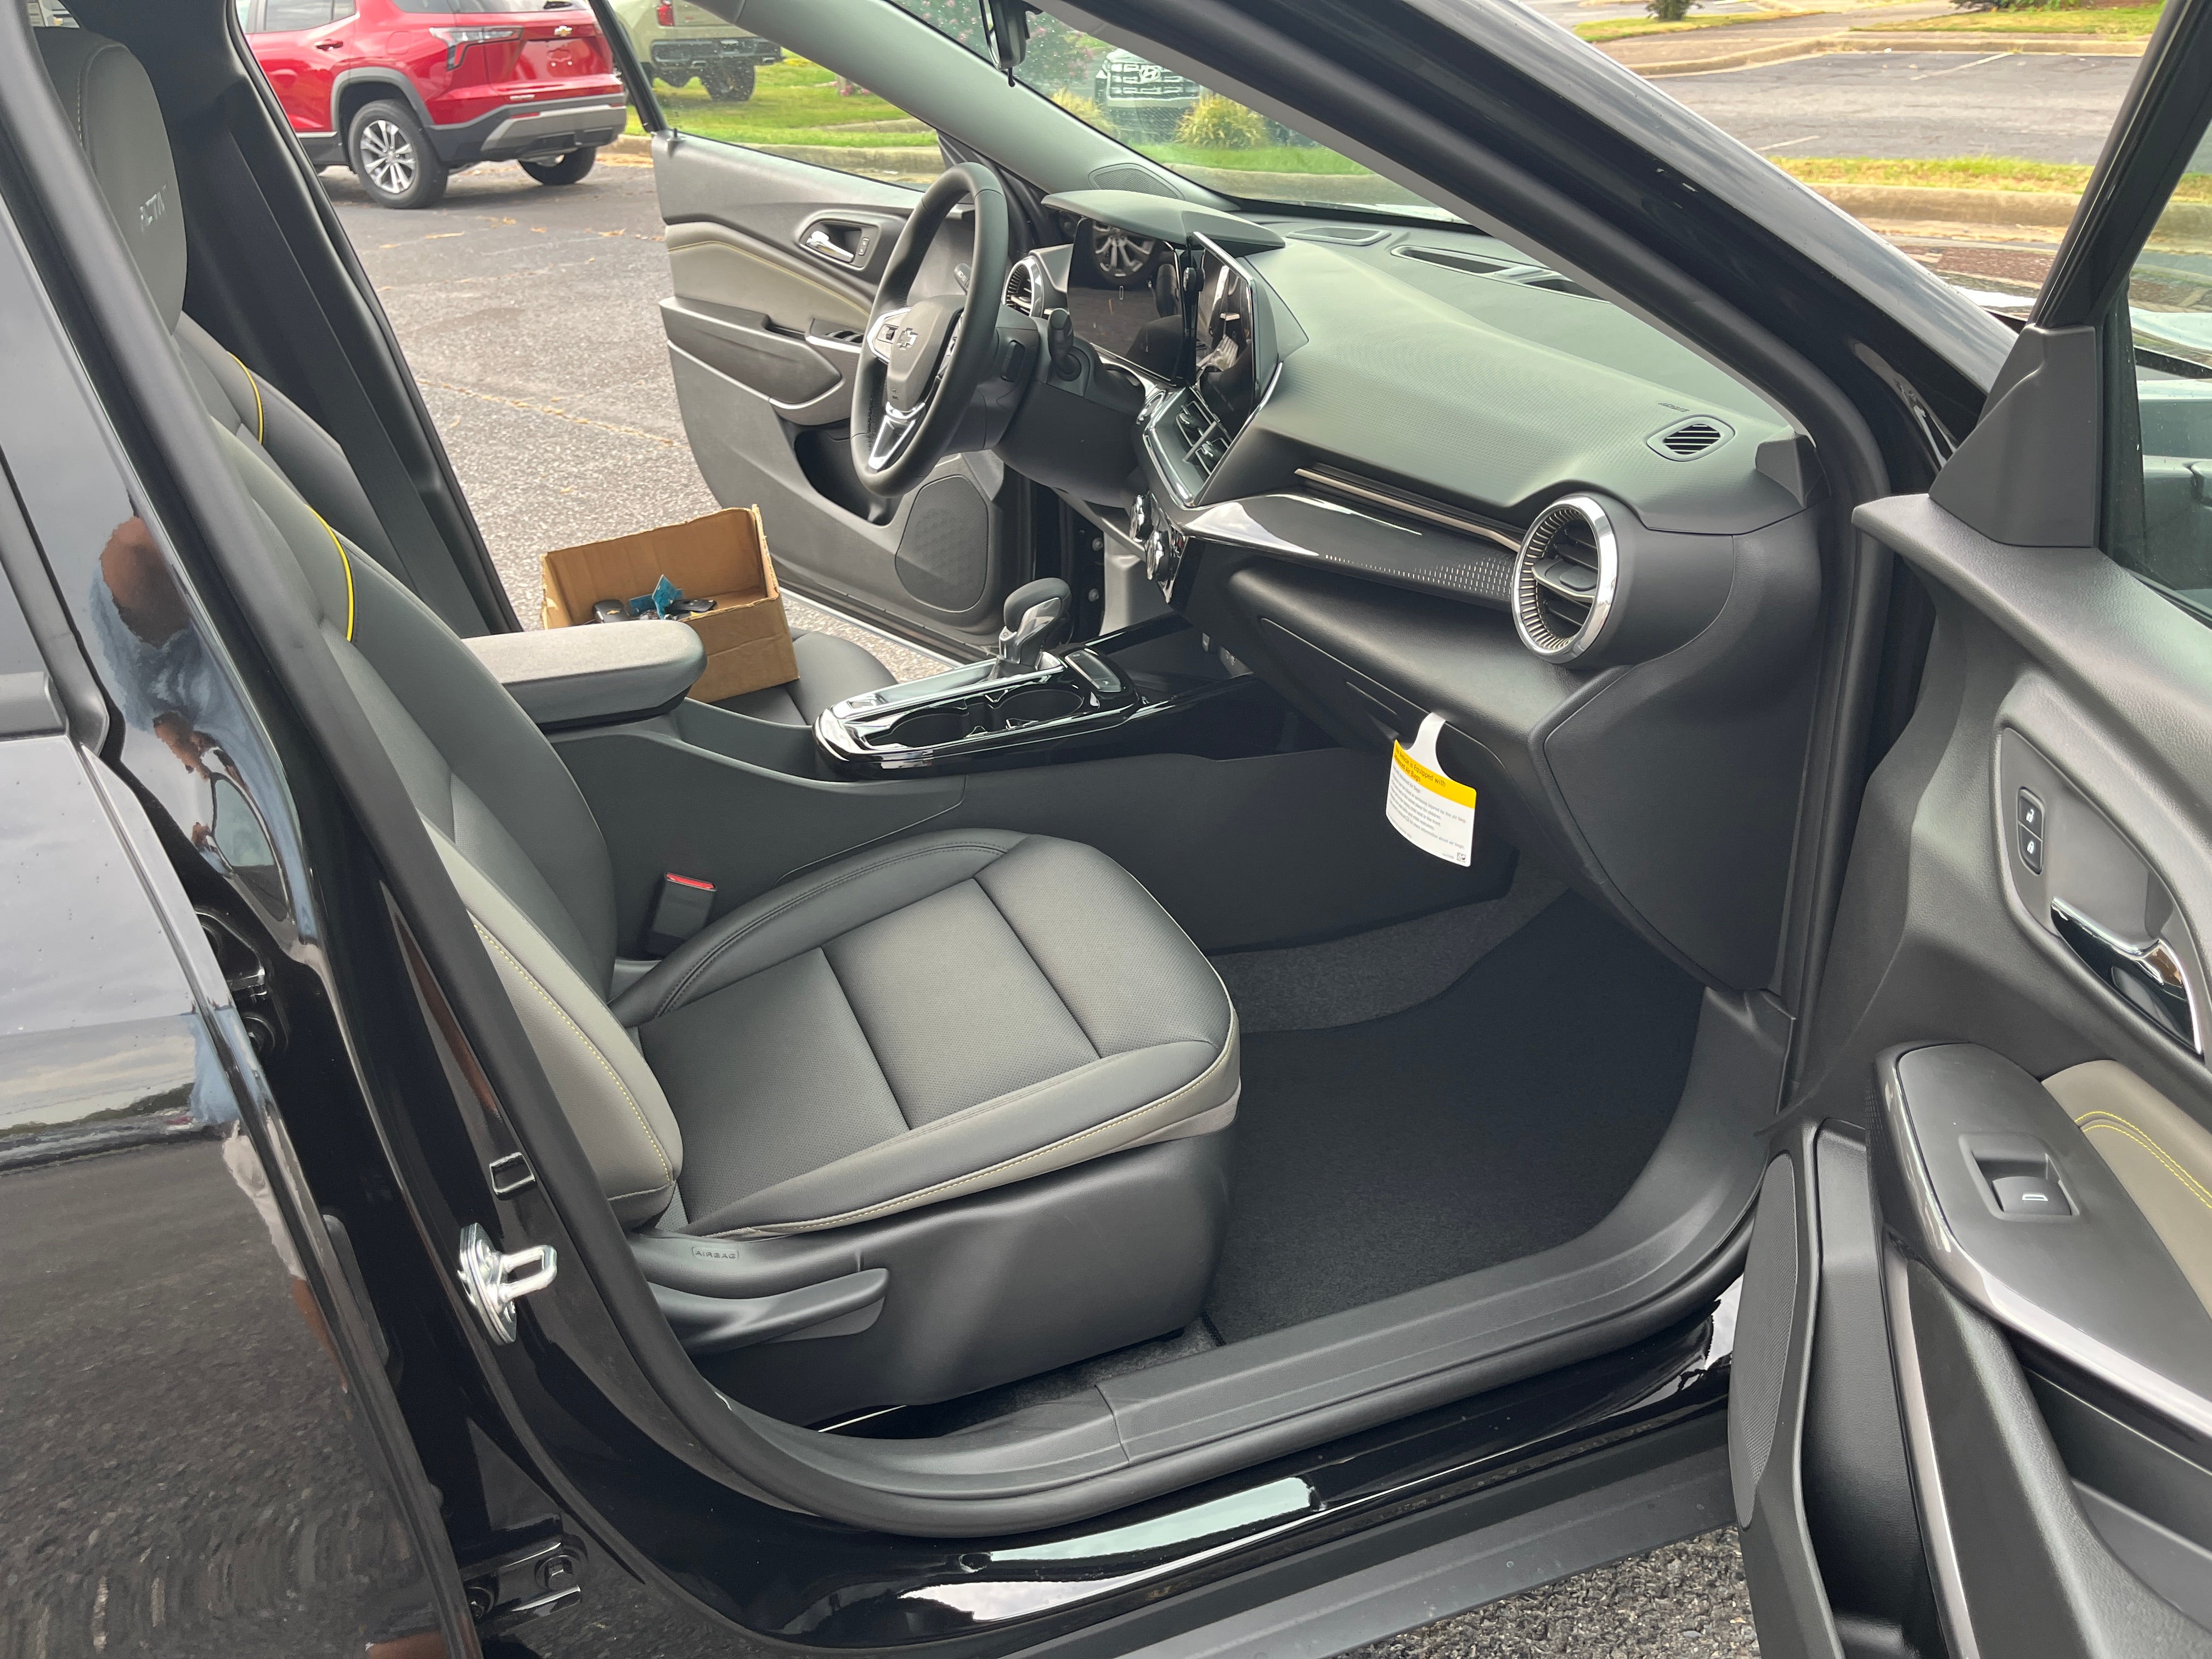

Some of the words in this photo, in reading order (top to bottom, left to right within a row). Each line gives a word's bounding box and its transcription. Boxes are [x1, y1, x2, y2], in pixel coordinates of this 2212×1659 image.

[1410, 770, 1421, 782] Bags
[1414, 764, 1434, 781] Equipped
[1435, 778, 1446, 787] with
[695, 1250, 736, 1260] AIRBAG
